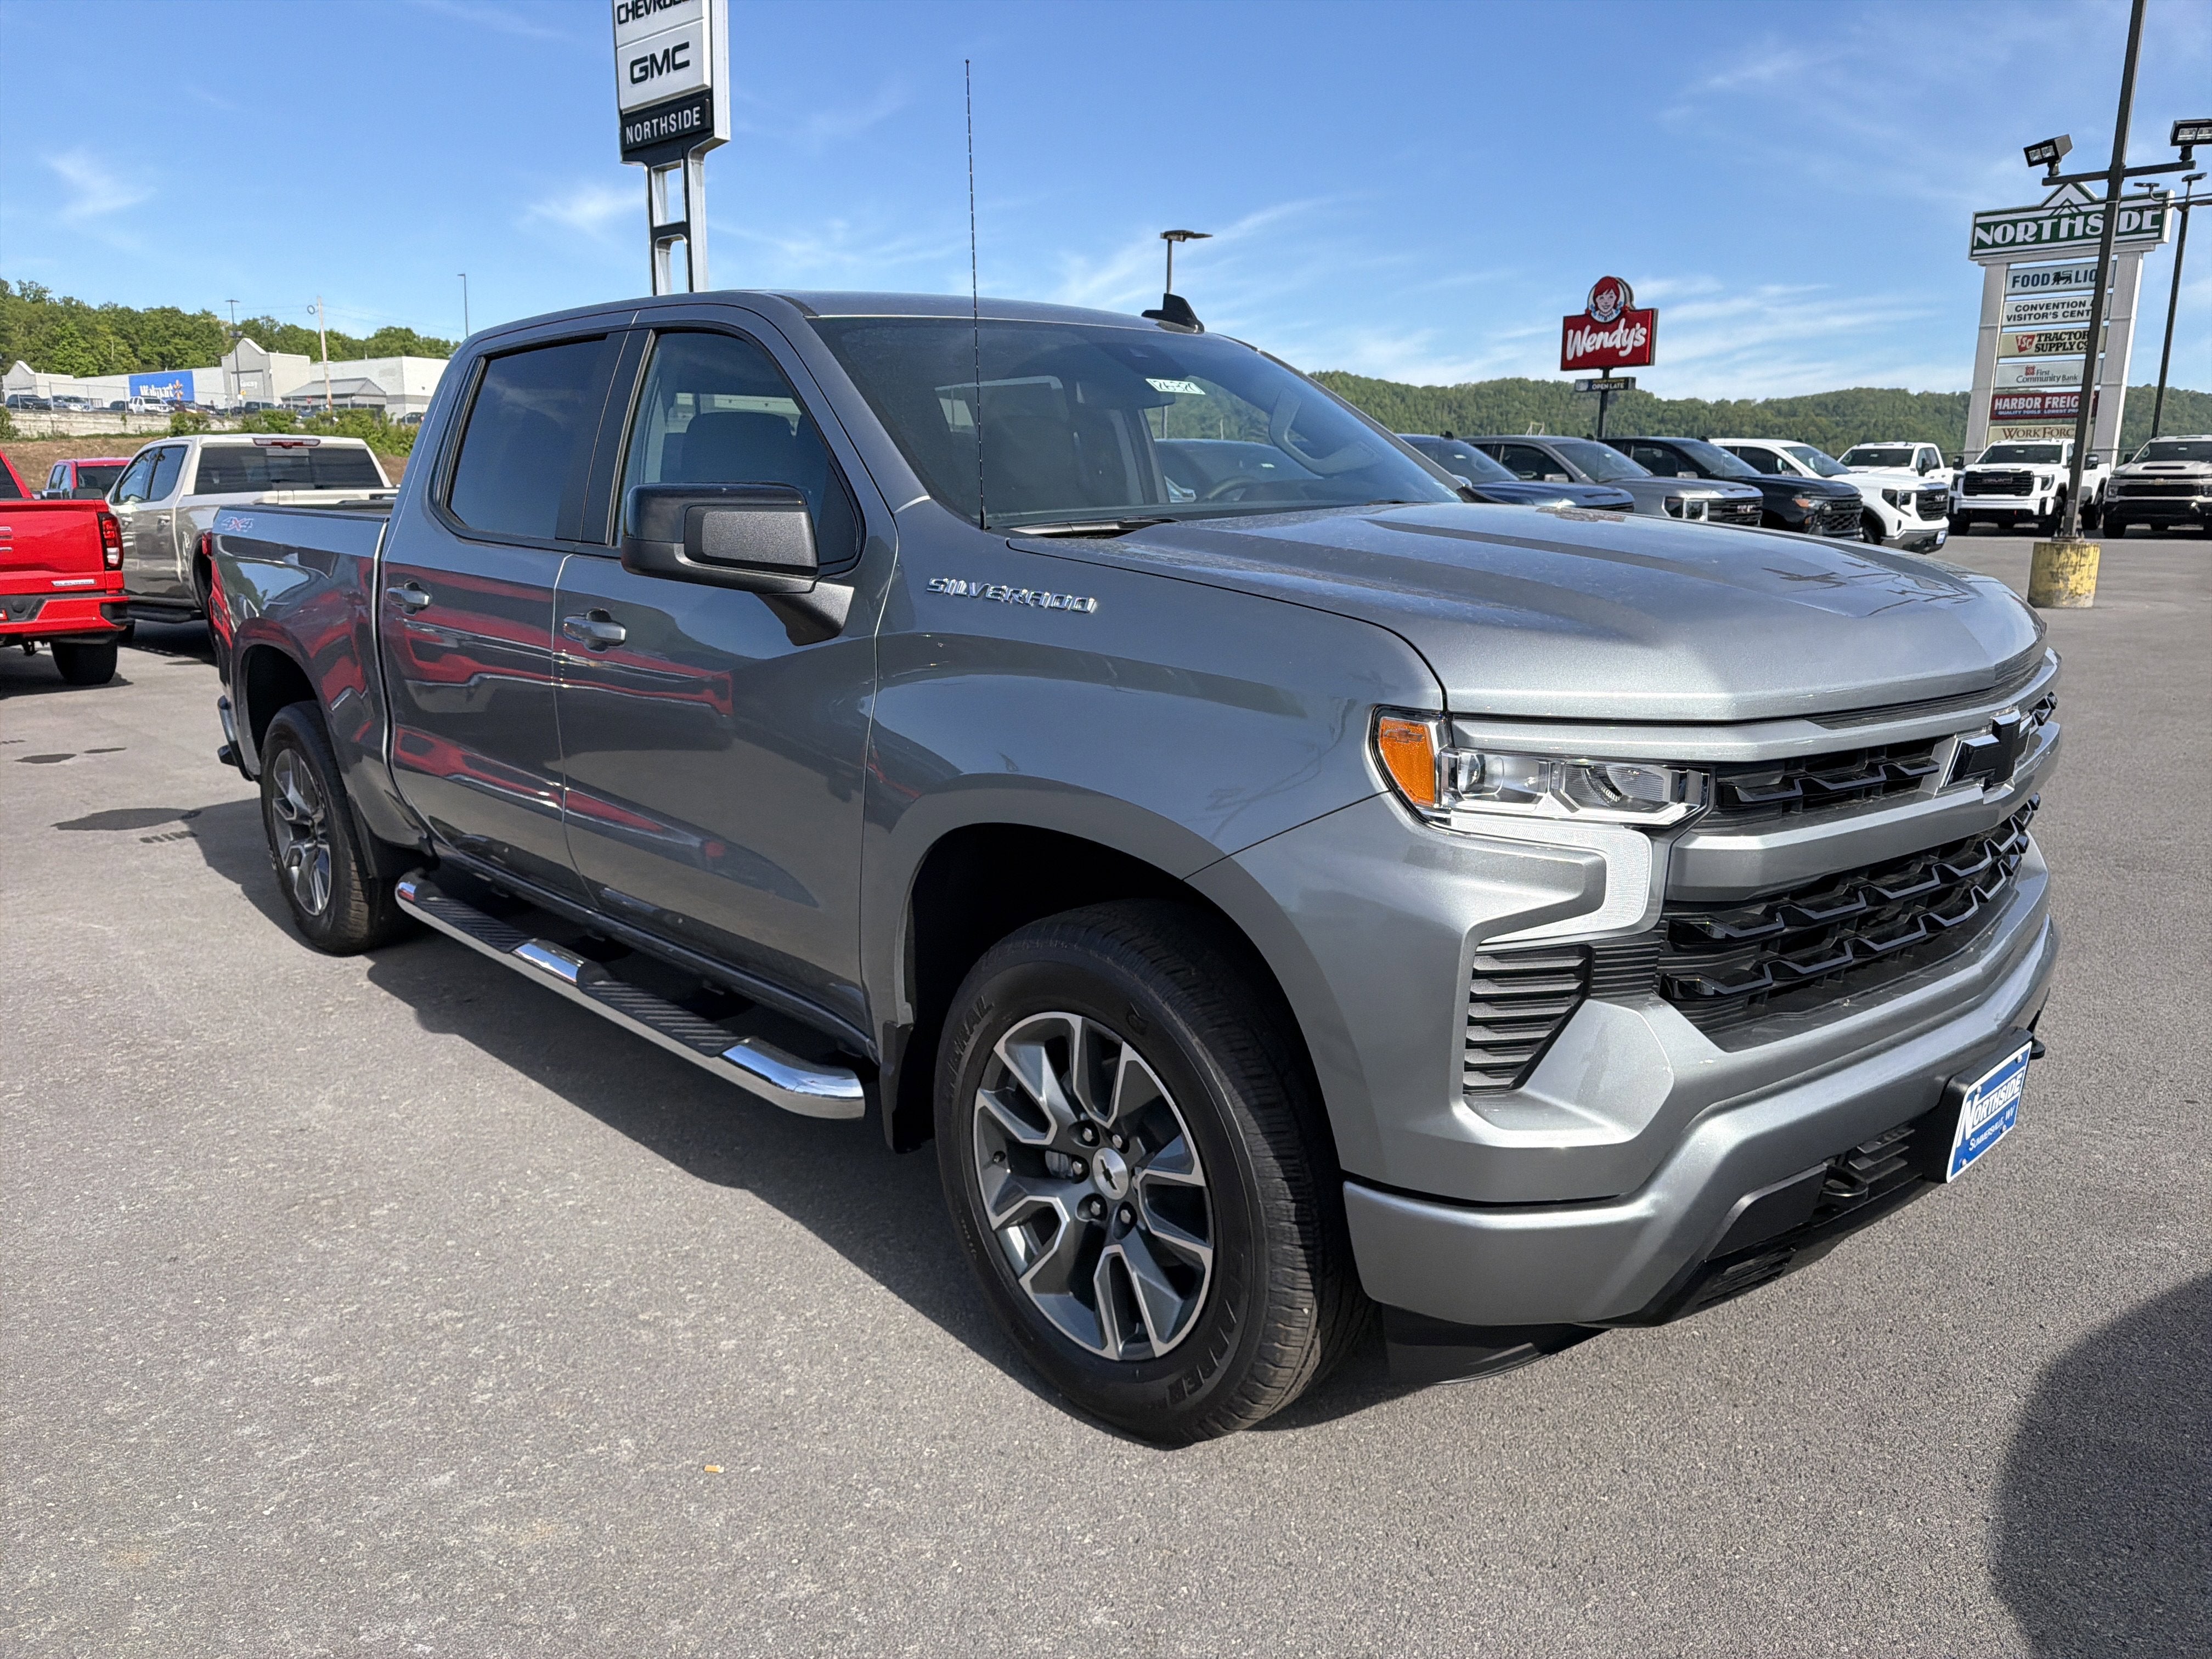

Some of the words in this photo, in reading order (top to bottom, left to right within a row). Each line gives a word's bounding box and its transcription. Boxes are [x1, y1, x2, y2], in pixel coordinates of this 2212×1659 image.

[617, 0, 692, 25] CHEVR
[630, 41, 690, 84] GMC
[626, 106, 701, 144] NORTHSIDE
[1975, 211, 2162, 247] NORTHSDE
[2012, 273, 2050, 288] FOOD
[2075, 269, 2098, 283] LIO
[2015, 300, 2086, 312] CONVENTION
[2007, 312, 2058, 322] VISITOR'S
[2062, 309, 2094, 318] CENT
[1567, 318, 1646, 361] Wendy's
[2036, 330, 2089, 342] TRACTOR
[2035, 342, 2076, 353] SUPPLY
[2016, 374, 2061, 383] Community
[139, 383, 174, 399] Walmart
[1994, 397, 2041, 410] HARBOR
[2045, 396, 2079, 408] FREIG
[2002, 428, 2041, 439] WORK
[2042, 427, 2074, 438] FORC
[926, 577, 1098, 614] SILVERADO
[2005, 1104, 2016, 1121] WV
